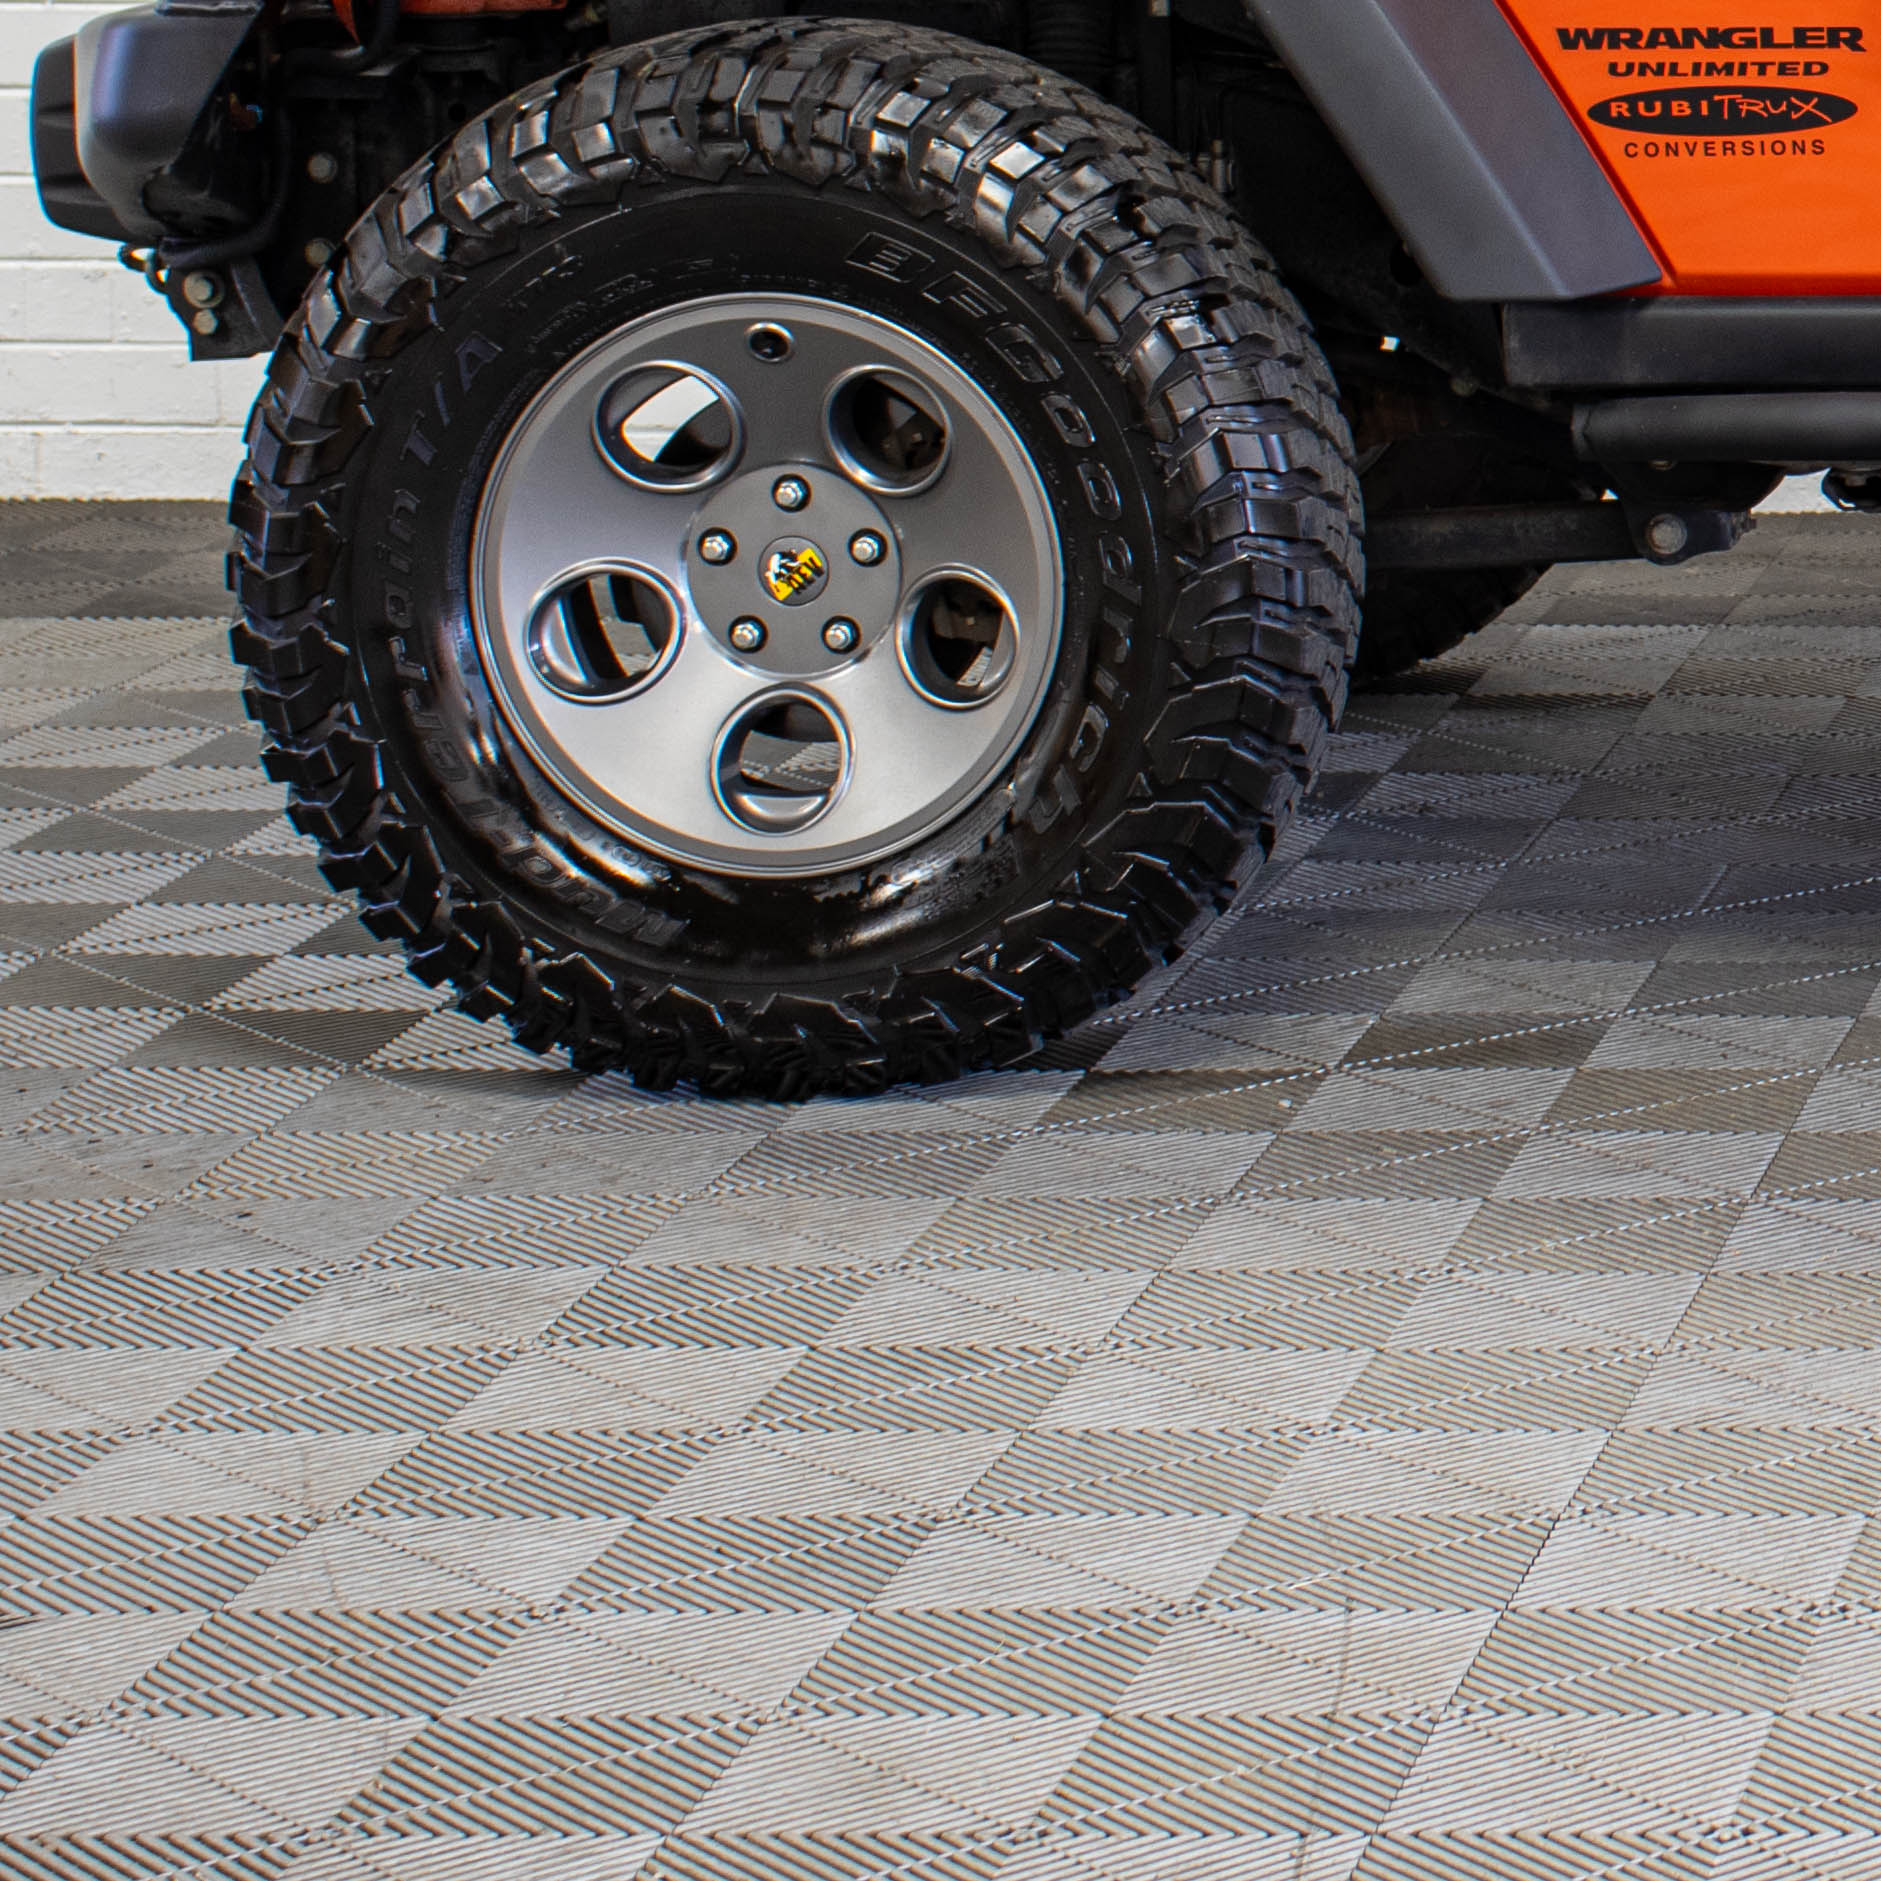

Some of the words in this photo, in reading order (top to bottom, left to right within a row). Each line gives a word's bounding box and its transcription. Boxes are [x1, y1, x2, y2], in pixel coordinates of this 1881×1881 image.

[1555, 26, 1867, 52] WRANGLER
[1607, 61, 1829, 77] UNLIMITED
[1624, 139, 1825, 158] CONVERSIONS
